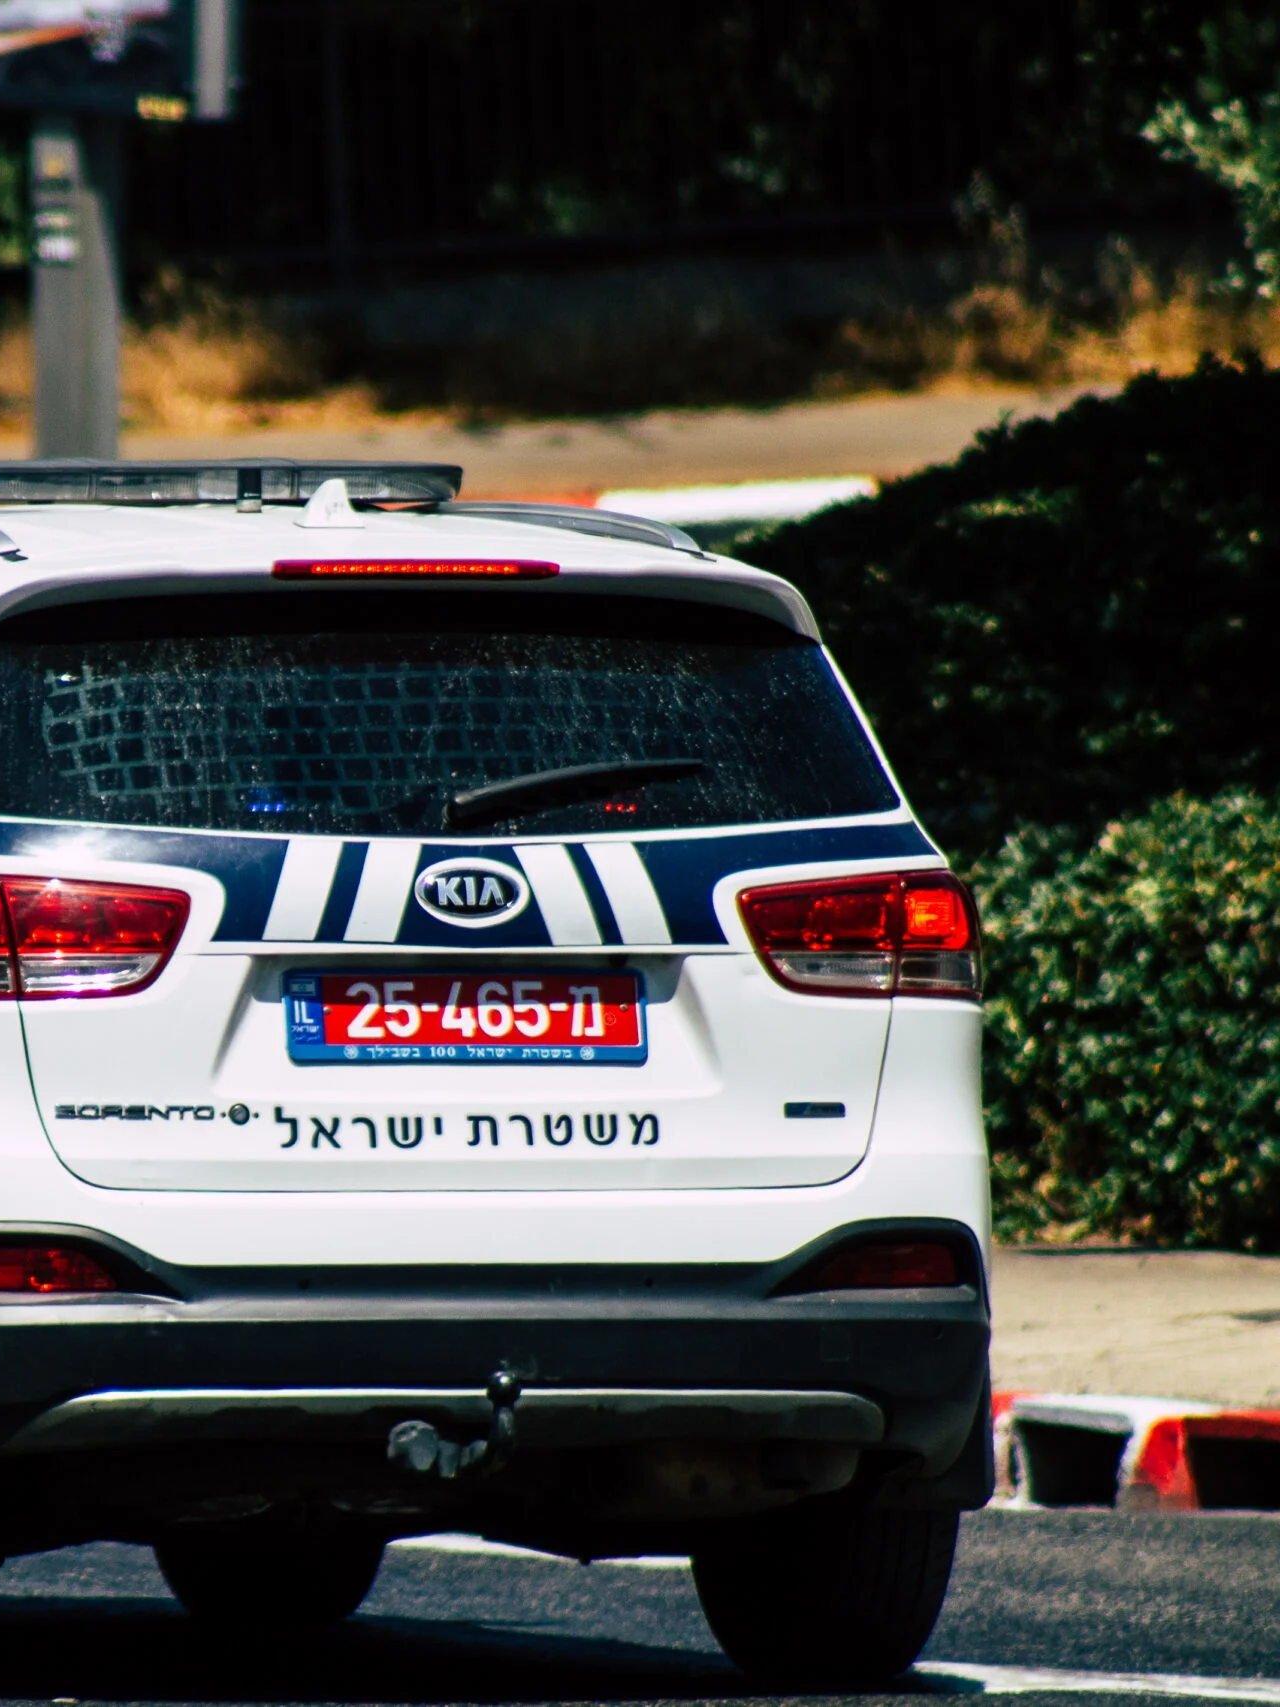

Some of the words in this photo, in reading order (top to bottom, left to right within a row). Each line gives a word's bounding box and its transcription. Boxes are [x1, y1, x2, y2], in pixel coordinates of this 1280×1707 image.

[435, 876, 505, 907] KIA
[293, 999, 315, 1024] IL
[366, 1046, 421, 1060] בשבילך
[429, 1046, 457, 1057] 100
[466, 1045, 512, 1058] ישראל
[521, 1049, 572, 1059] משטרת
[54, 1104, 215, 1121] SORENTO
[273, 1105, 443, 1150] ישראל
[466, 1112, 660, 1147] משטרת
